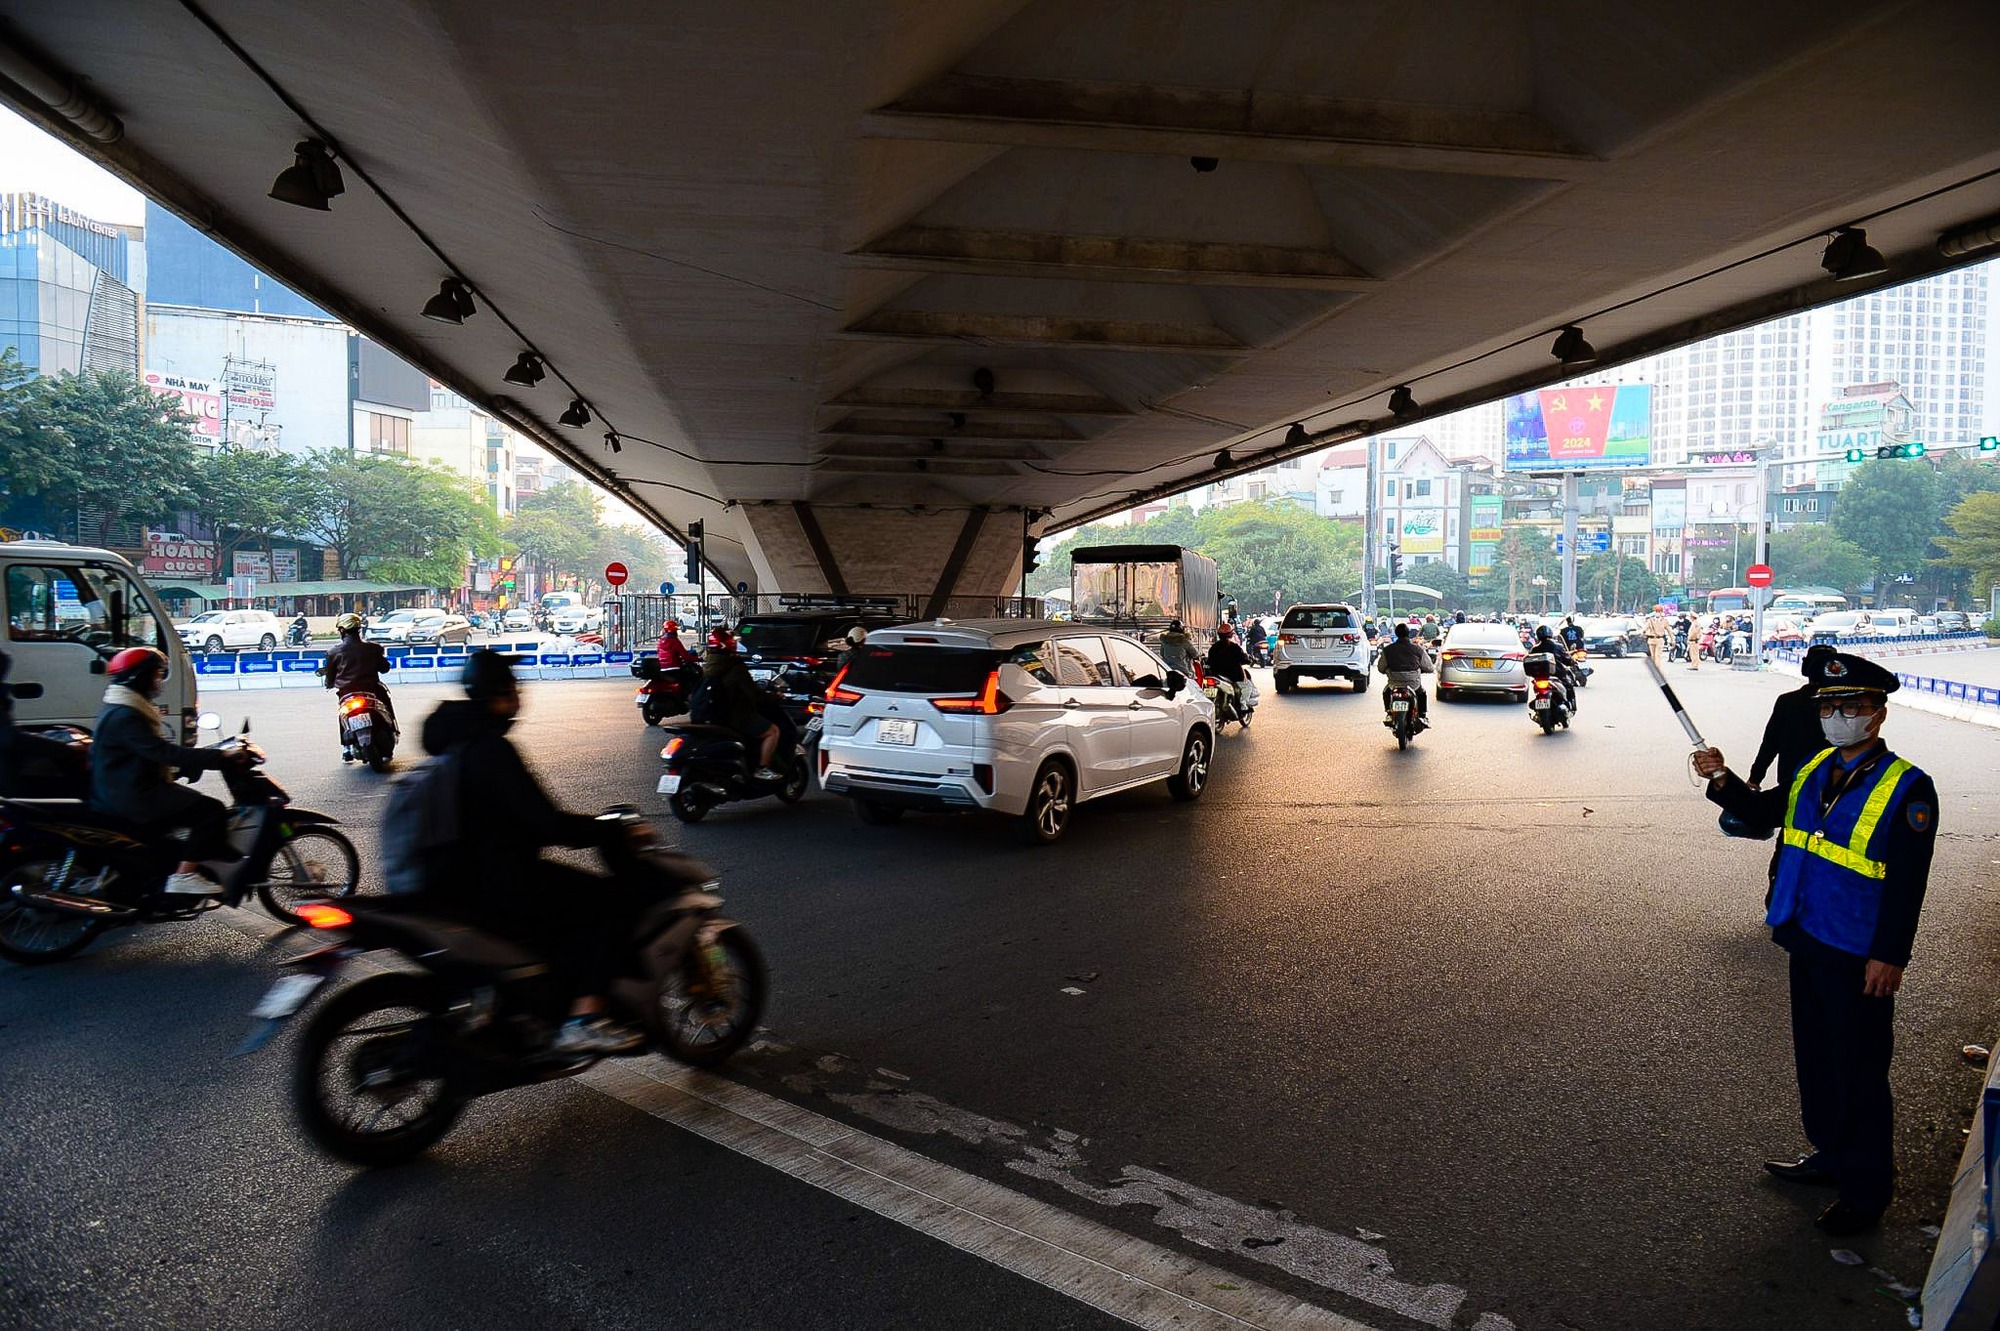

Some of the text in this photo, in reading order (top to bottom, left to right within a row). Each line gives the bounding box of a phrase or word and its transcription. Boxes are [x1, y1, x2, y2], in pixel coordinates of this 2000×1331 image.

[89, 222, 118, 239] CENTER
[189, 381, 210, 392] MAY
[1562, 437, 1592, 448] 2024
